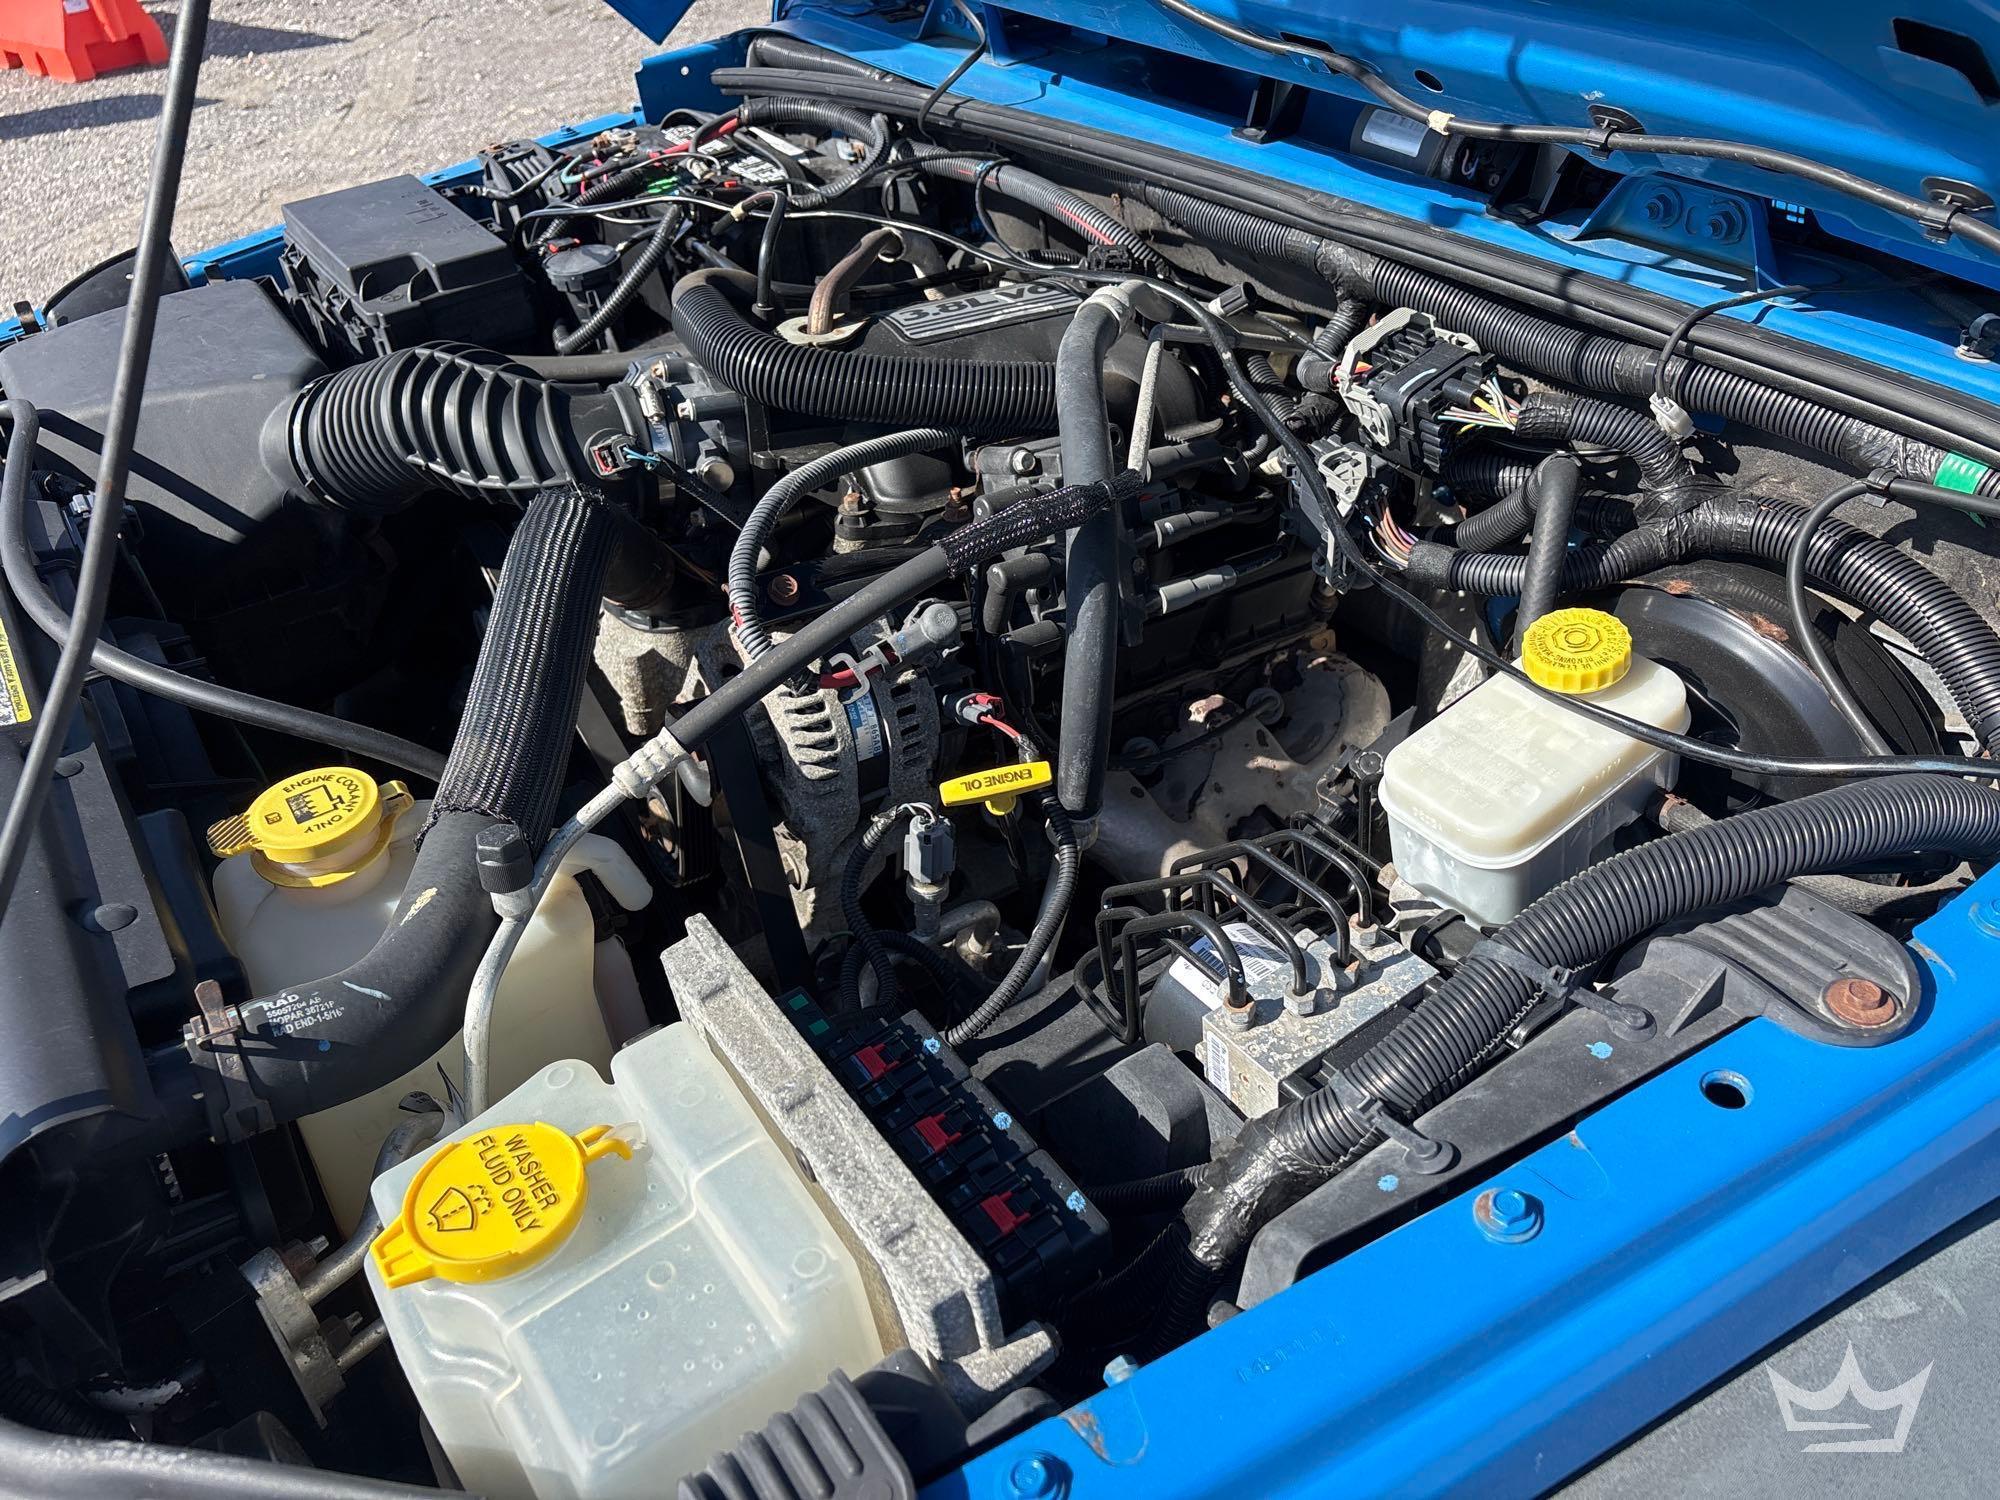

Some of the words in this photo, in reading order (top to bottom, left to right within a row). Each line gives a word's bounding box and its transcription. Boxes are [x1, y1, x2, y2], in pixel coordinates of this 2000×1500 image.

[899, 297, 1000, 322] 3.8L
[995, 282, 1059, 301] V6
[282, 774, 335, 793] ENGINE
[960, 778, 982, 792] OIL
[984, 768, 1033, 788] ENGINE
[336, 776, 360, 813] COOLANT
[304, 814, 343, 834] ONLY
[261, 994, 299, 1011] RAD
[505, 1133, 558, 1211] WASHER
[473, 1135, 512, 1186] FLUID
[502, 1187, 541, 1233] ONLY
